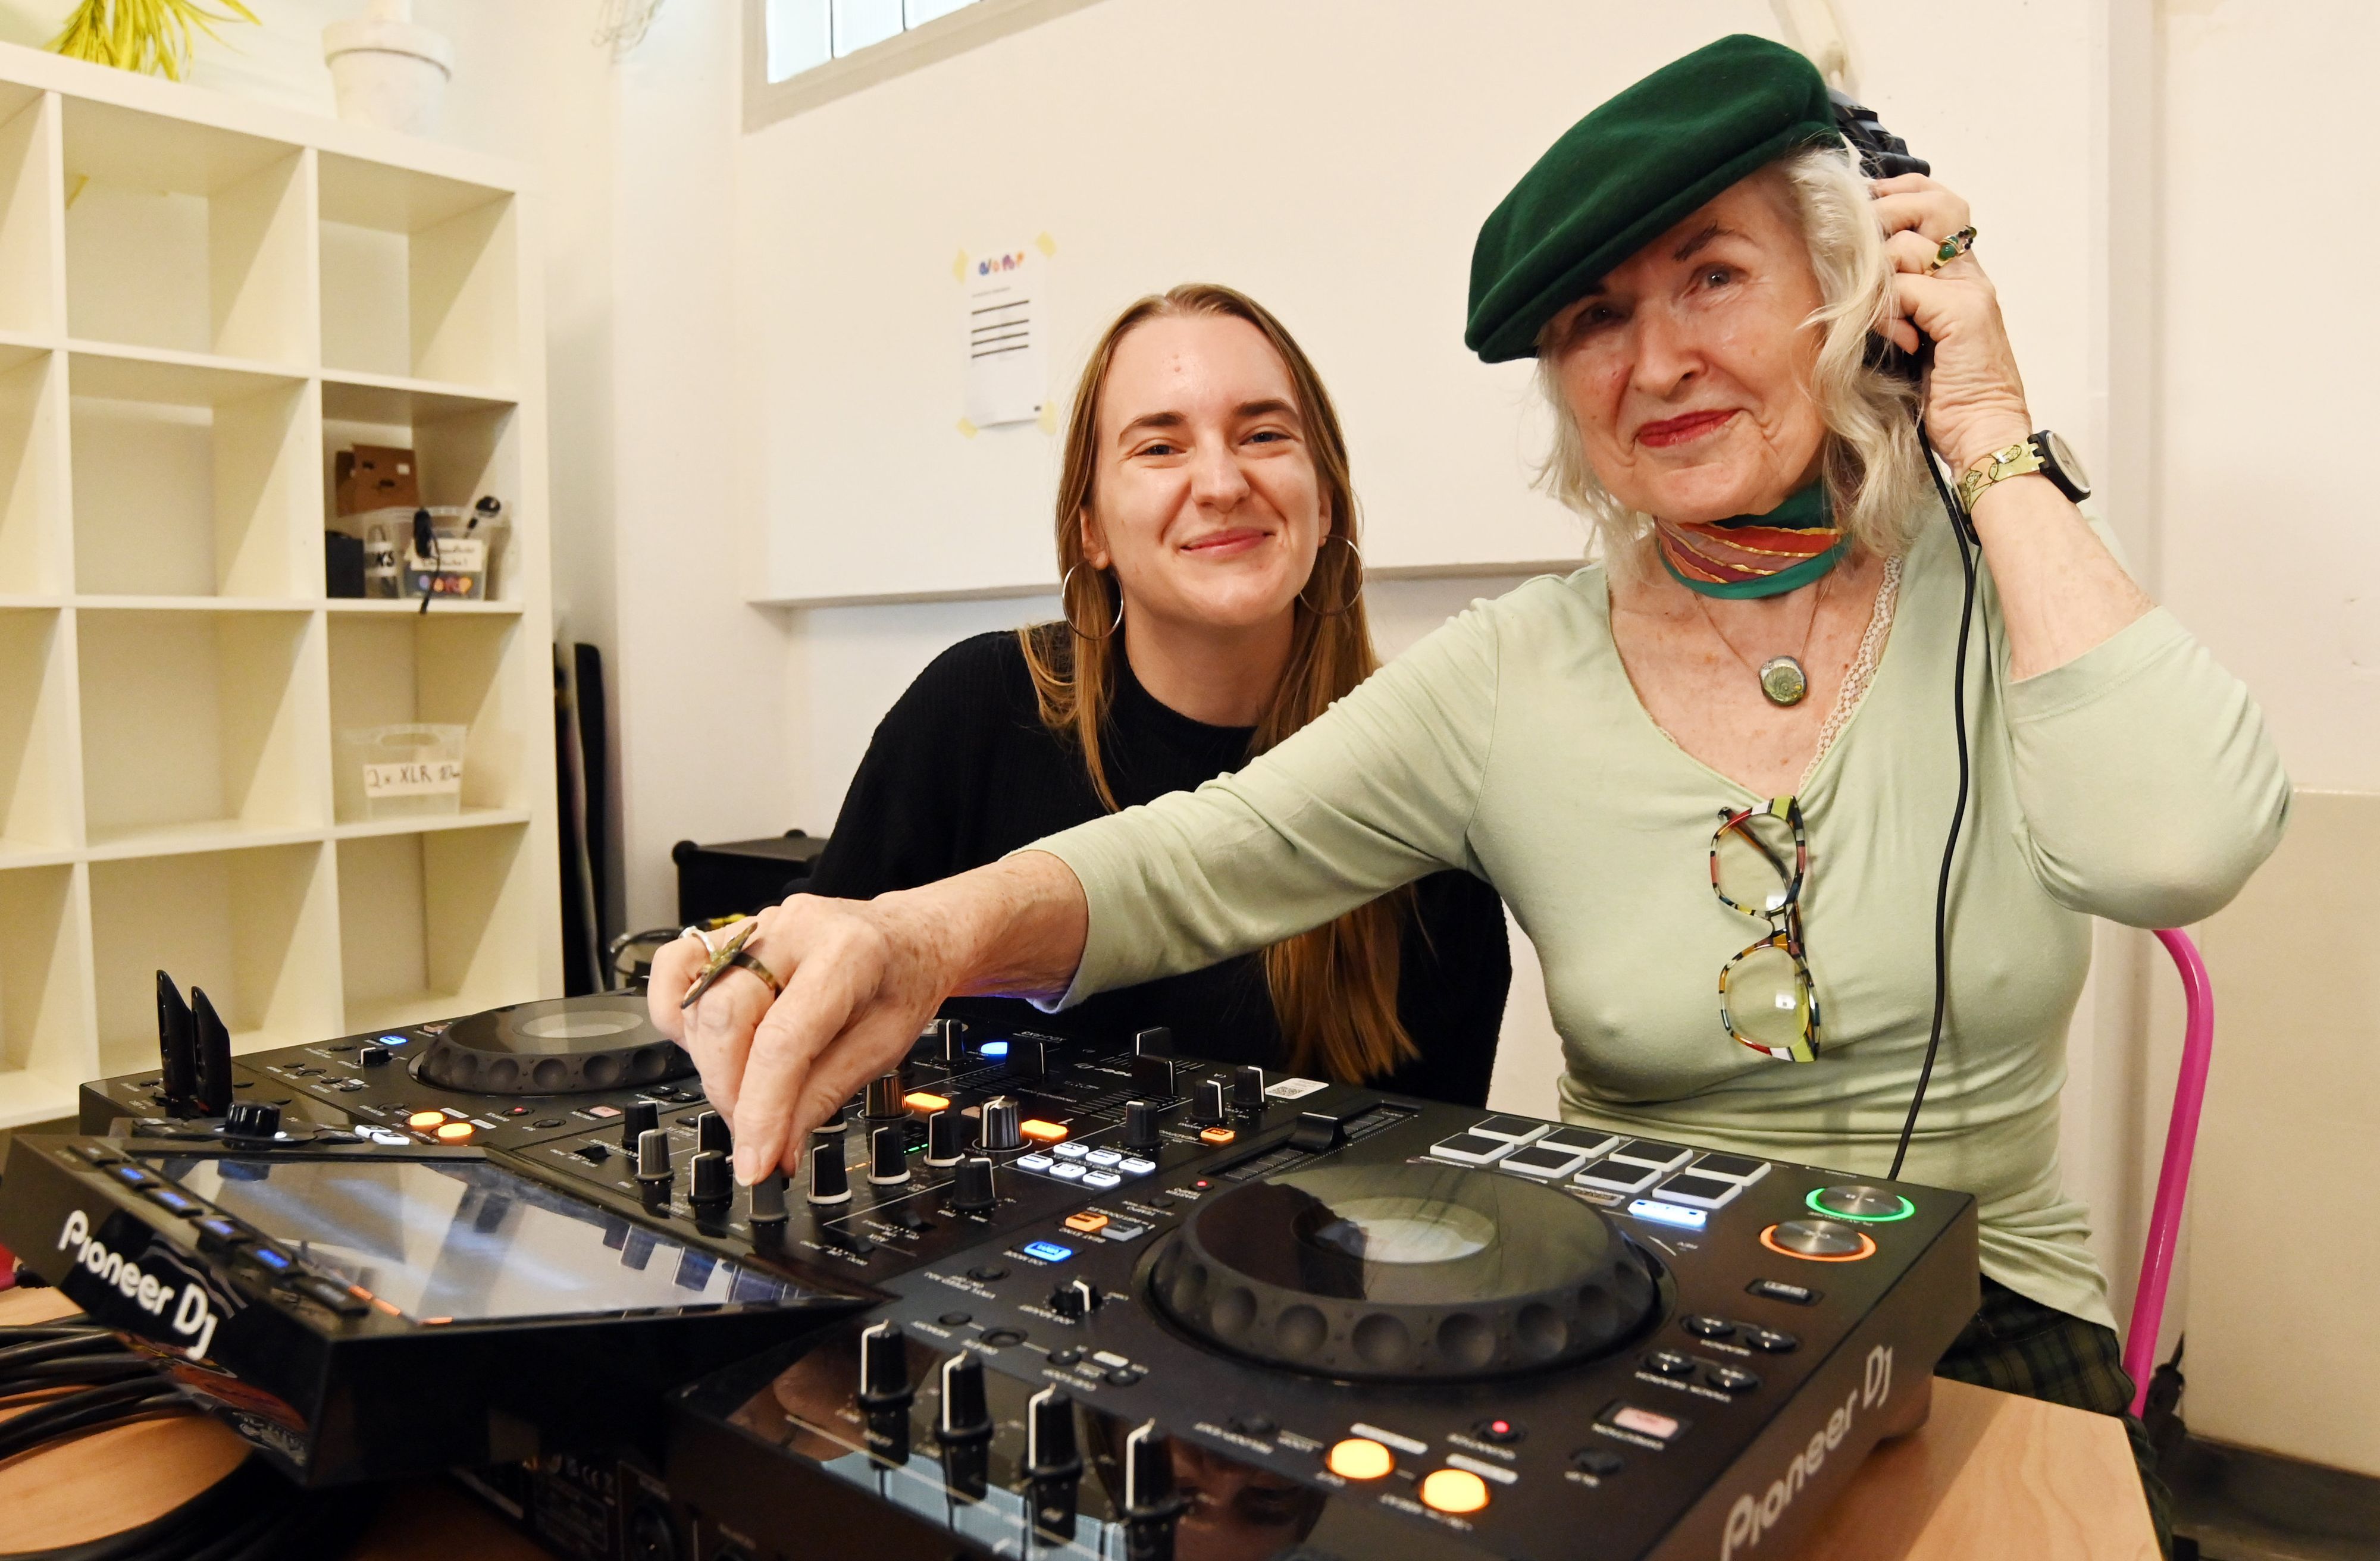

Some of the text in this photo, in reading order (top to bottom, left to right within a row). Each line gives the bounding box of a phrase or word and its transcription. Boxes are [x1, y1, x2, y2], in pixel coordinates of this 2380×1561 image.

[58, 1209, 218, 1361] Pioneer DJ
[1720, 1388, 1858, 1561] Pioneer
[1862, 1345, 1893, 1410] DJ
